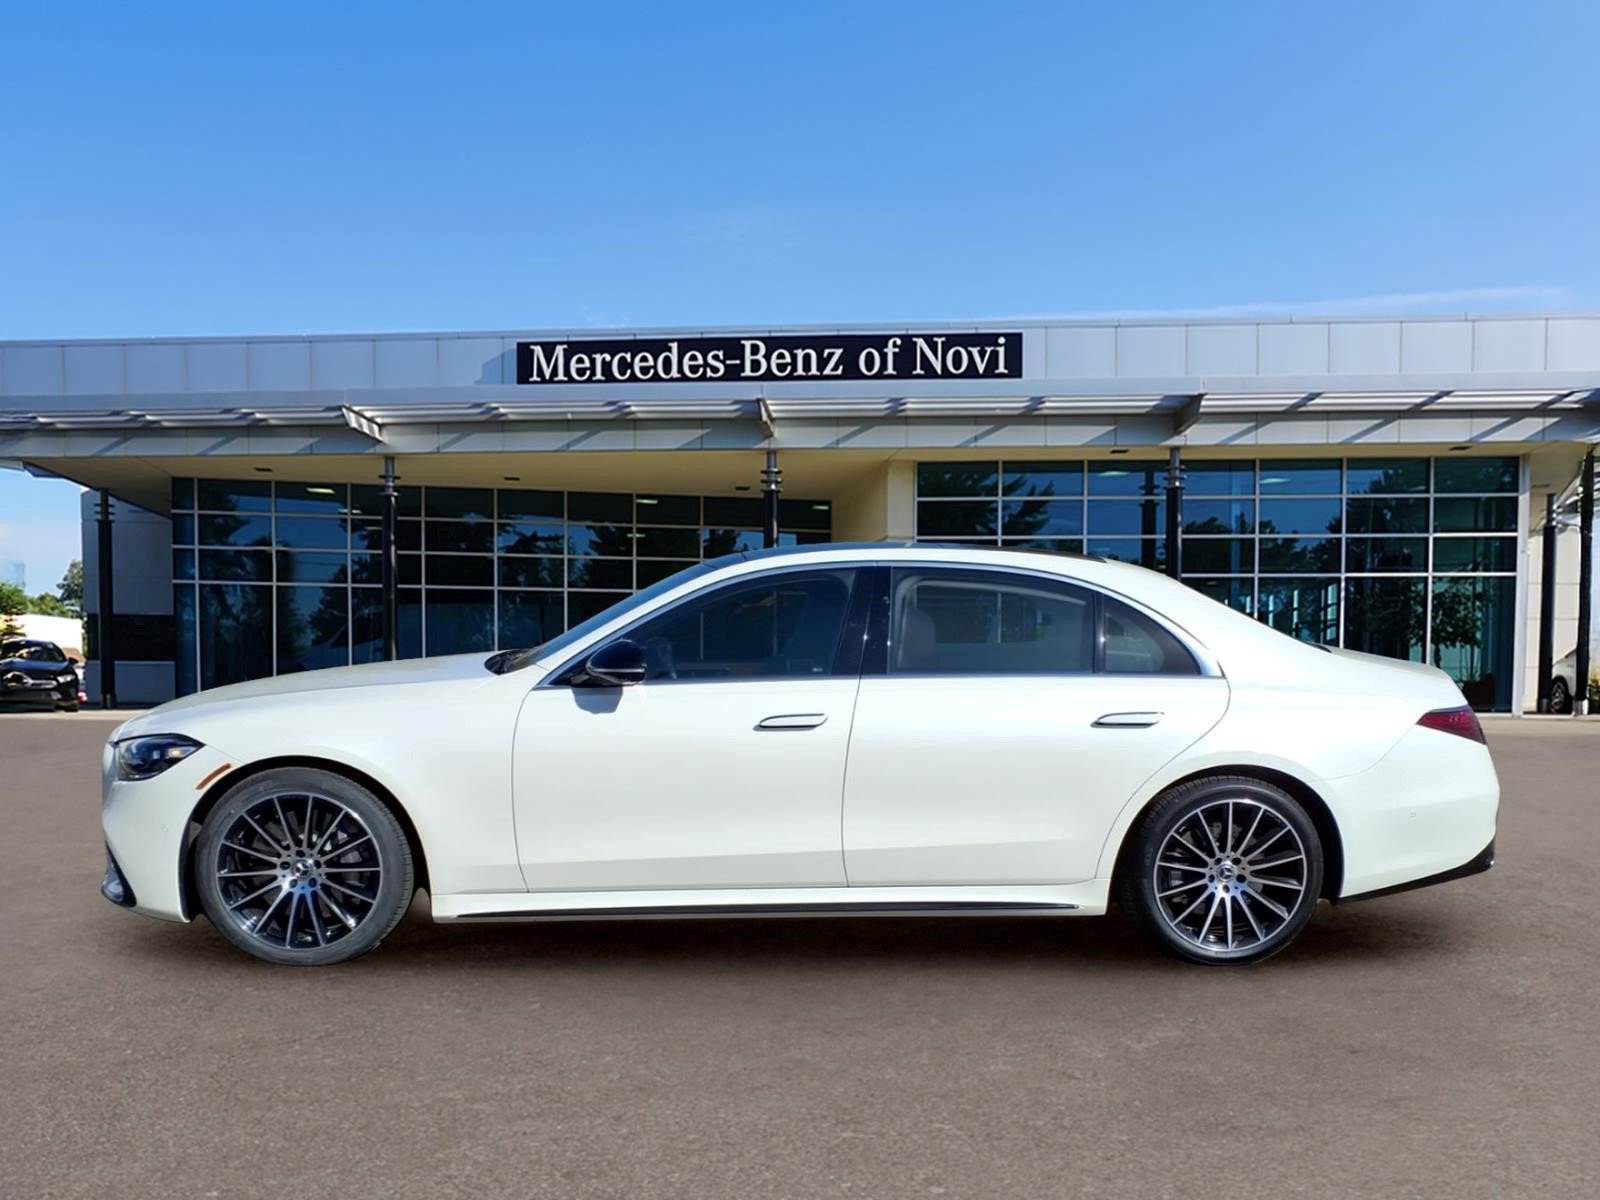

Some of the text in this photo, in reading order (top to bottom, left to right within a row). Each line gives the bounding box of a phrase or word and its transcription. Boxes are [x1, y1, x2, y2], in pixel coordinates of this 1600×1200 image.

[529, 336, 1009, 382] Mercedes-Benz of Novi
